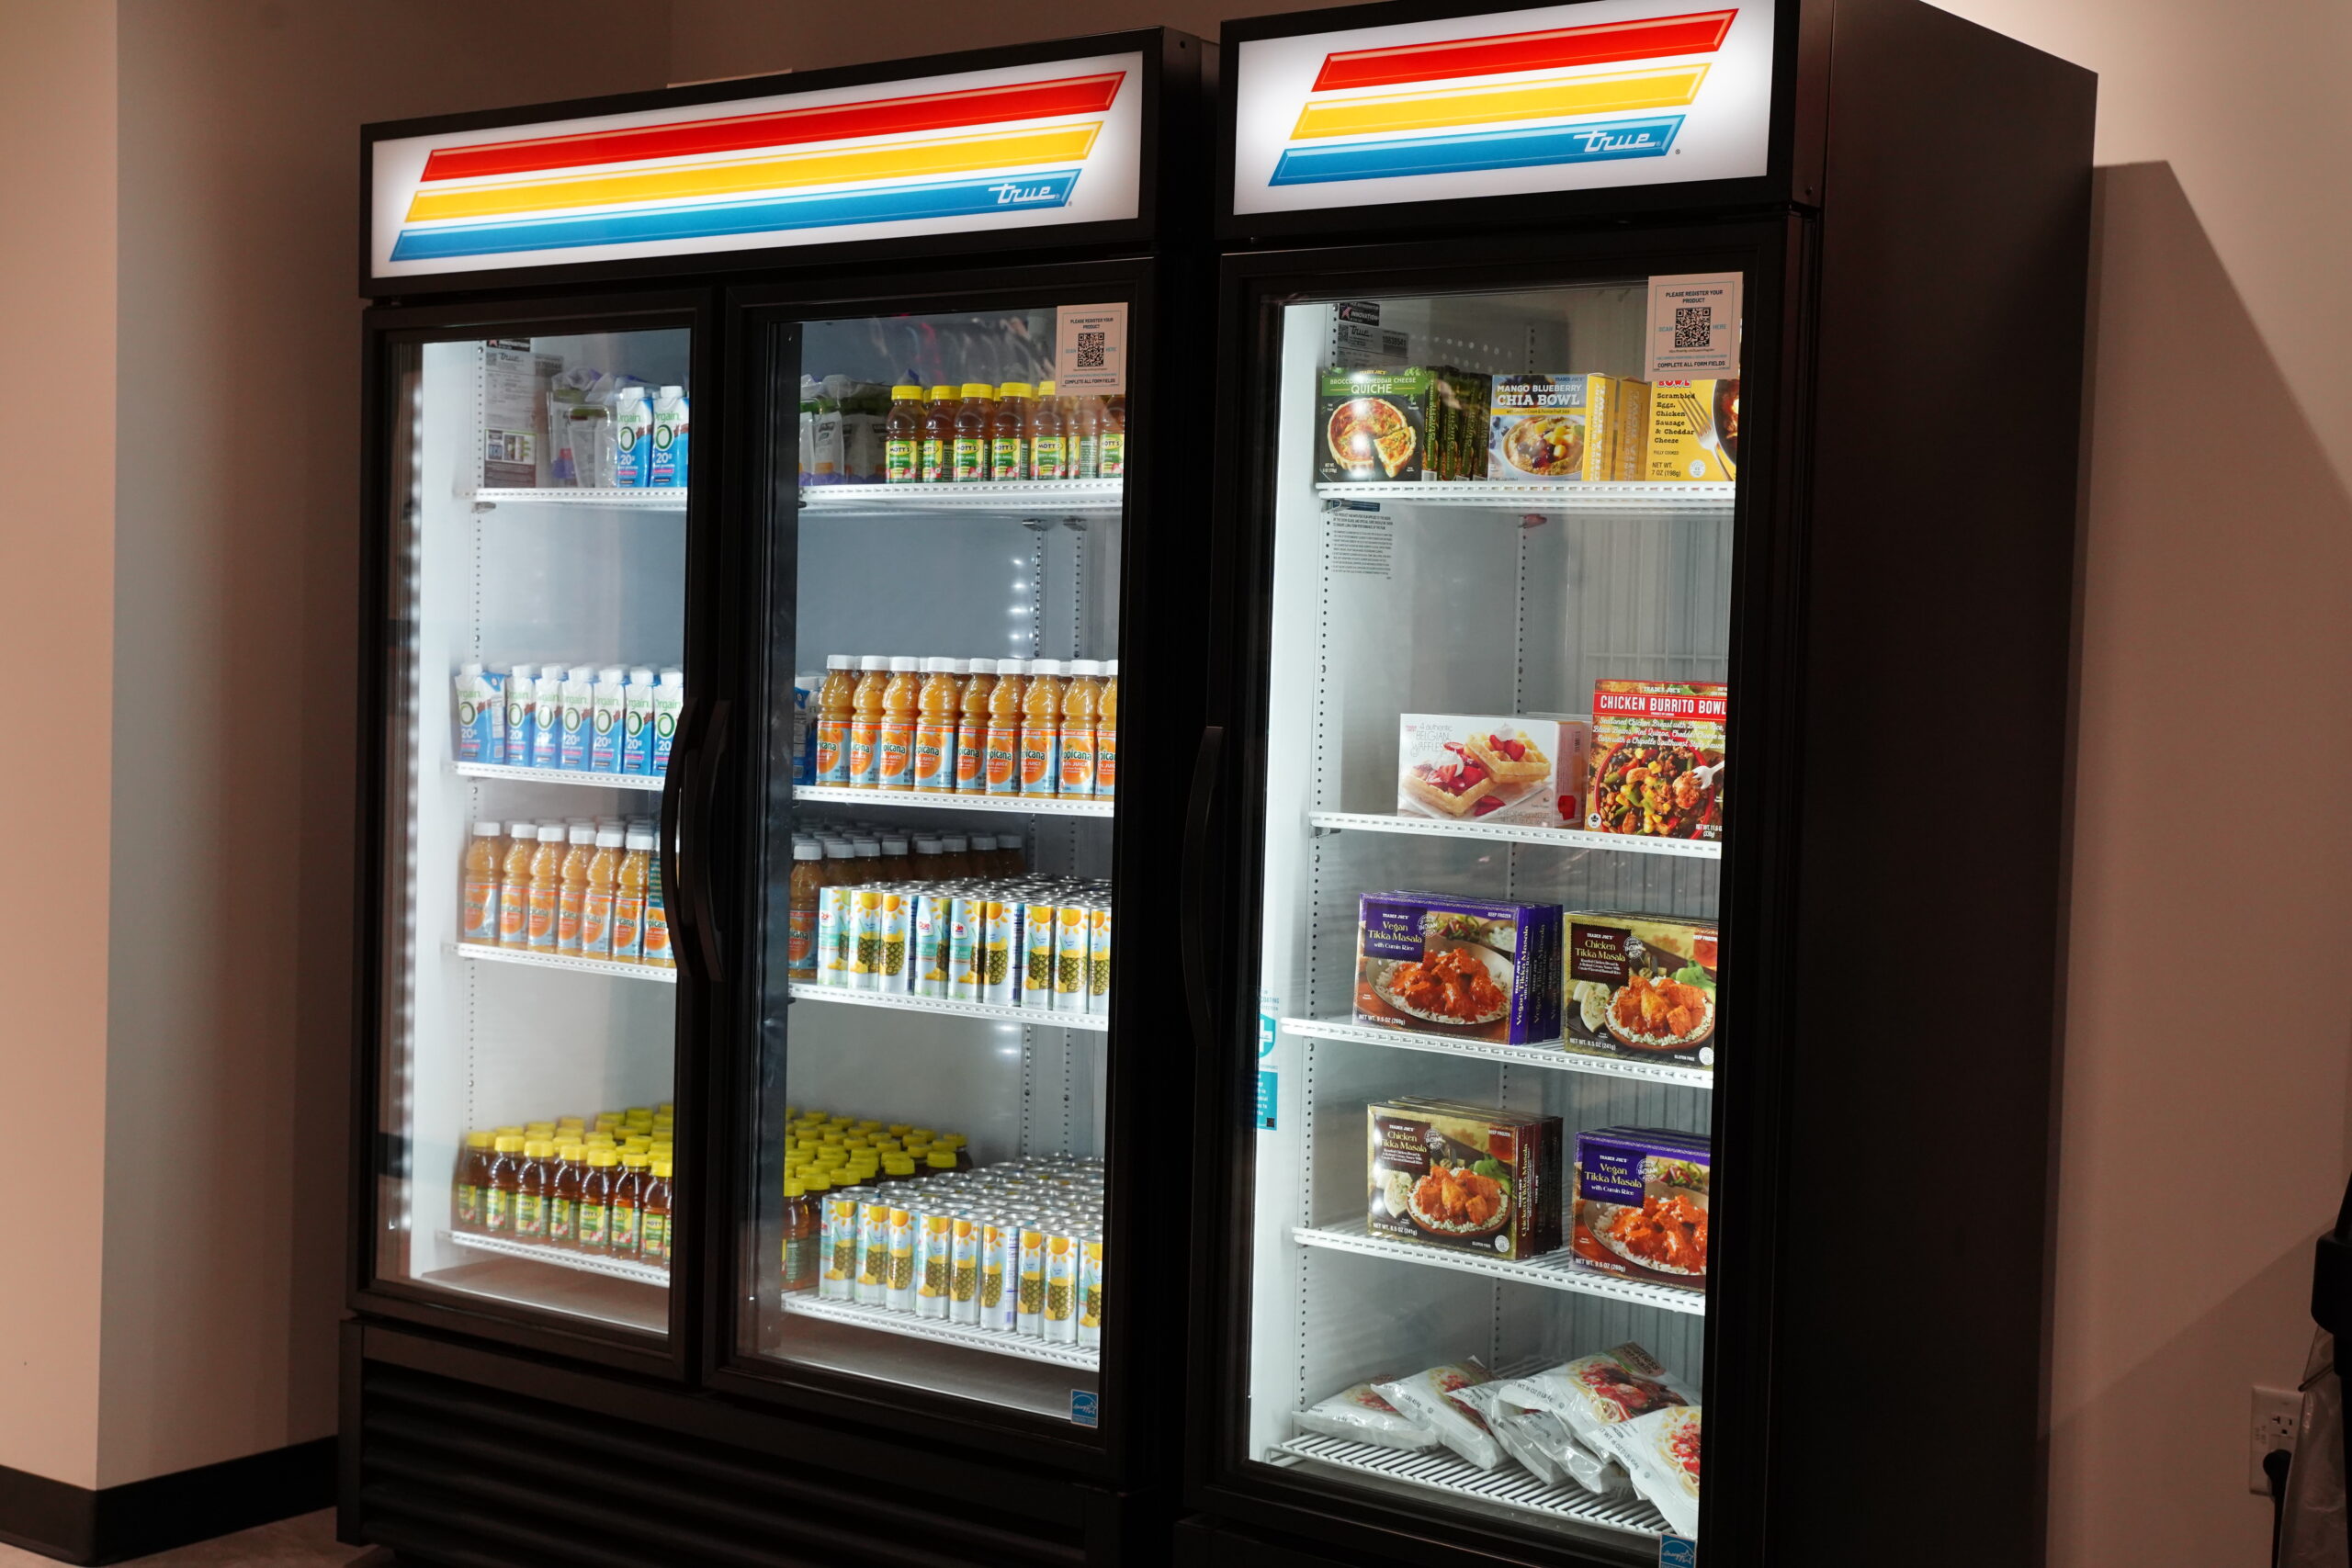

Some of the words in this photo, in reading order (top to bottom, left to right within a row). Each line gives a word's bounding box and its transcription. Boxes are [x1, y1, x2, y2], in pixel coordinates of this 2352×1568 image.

[1573, 130, 1656, 153] true
[988, 183, 1056, 205] true
[1351, 384, 1393, 394] QUICHE
[1497, 385, 1531, 393] MANGO
[1532, 384, 1582, 393] BLUEBERRY
[1497, 394, 1534, 407] CHIA
[1537, 394, 1581, 407] BOWL
[1655, 419, 1685, 427] Sausage
[1600, 695, 1646, 711] CHICKEN
[1650, 697, 1695, 714] BURRITO
[1698, 700, 1726, 716] BOWL
[1419, 722, 1426, 730] 4
[1600, 717, 1627, 726] Seasoned
[1628, 718, 1651, 727] Chicken
[1652, 719, 1672, 728] Breast
[1710, 722, 1724, 731] Rice,
[1416, 731, 1452, 741] BELGIAN
[1592, 725, 1611, 733] Black
[1647, 728, 1670, 738] Quinoa,
[1612, 736, 1625, 744] with
[1632, 737, 1656, 747] Chipotle
[1657, 738, 1689, 748] Southwest
[1382, 920, 1408, 932] Vegan
[1368, 929, 1391, 941] Tikka
[1392, 931, 1422, 943] Masala
[1584, 939, 1616, 951] Chicken
[1575, 947, 1598, 958] Tikka
[1598, 951, 1626, 962] Masala
[1516, 994, 1524, 1026] Vegan
[1521, 925, 1529, 963] Masala
[1602, 1042, 1617, 1051] (241g)
[1387, 1130, 1418, 1142] Chicken
[1400, 1141, 1428, 1153] Masala
[1600, 1163, 1628, 1176] Vegan
[1585, 1171, 1610, 1183] Tikka
[1611, 1174, 1643, 1188] Masala
